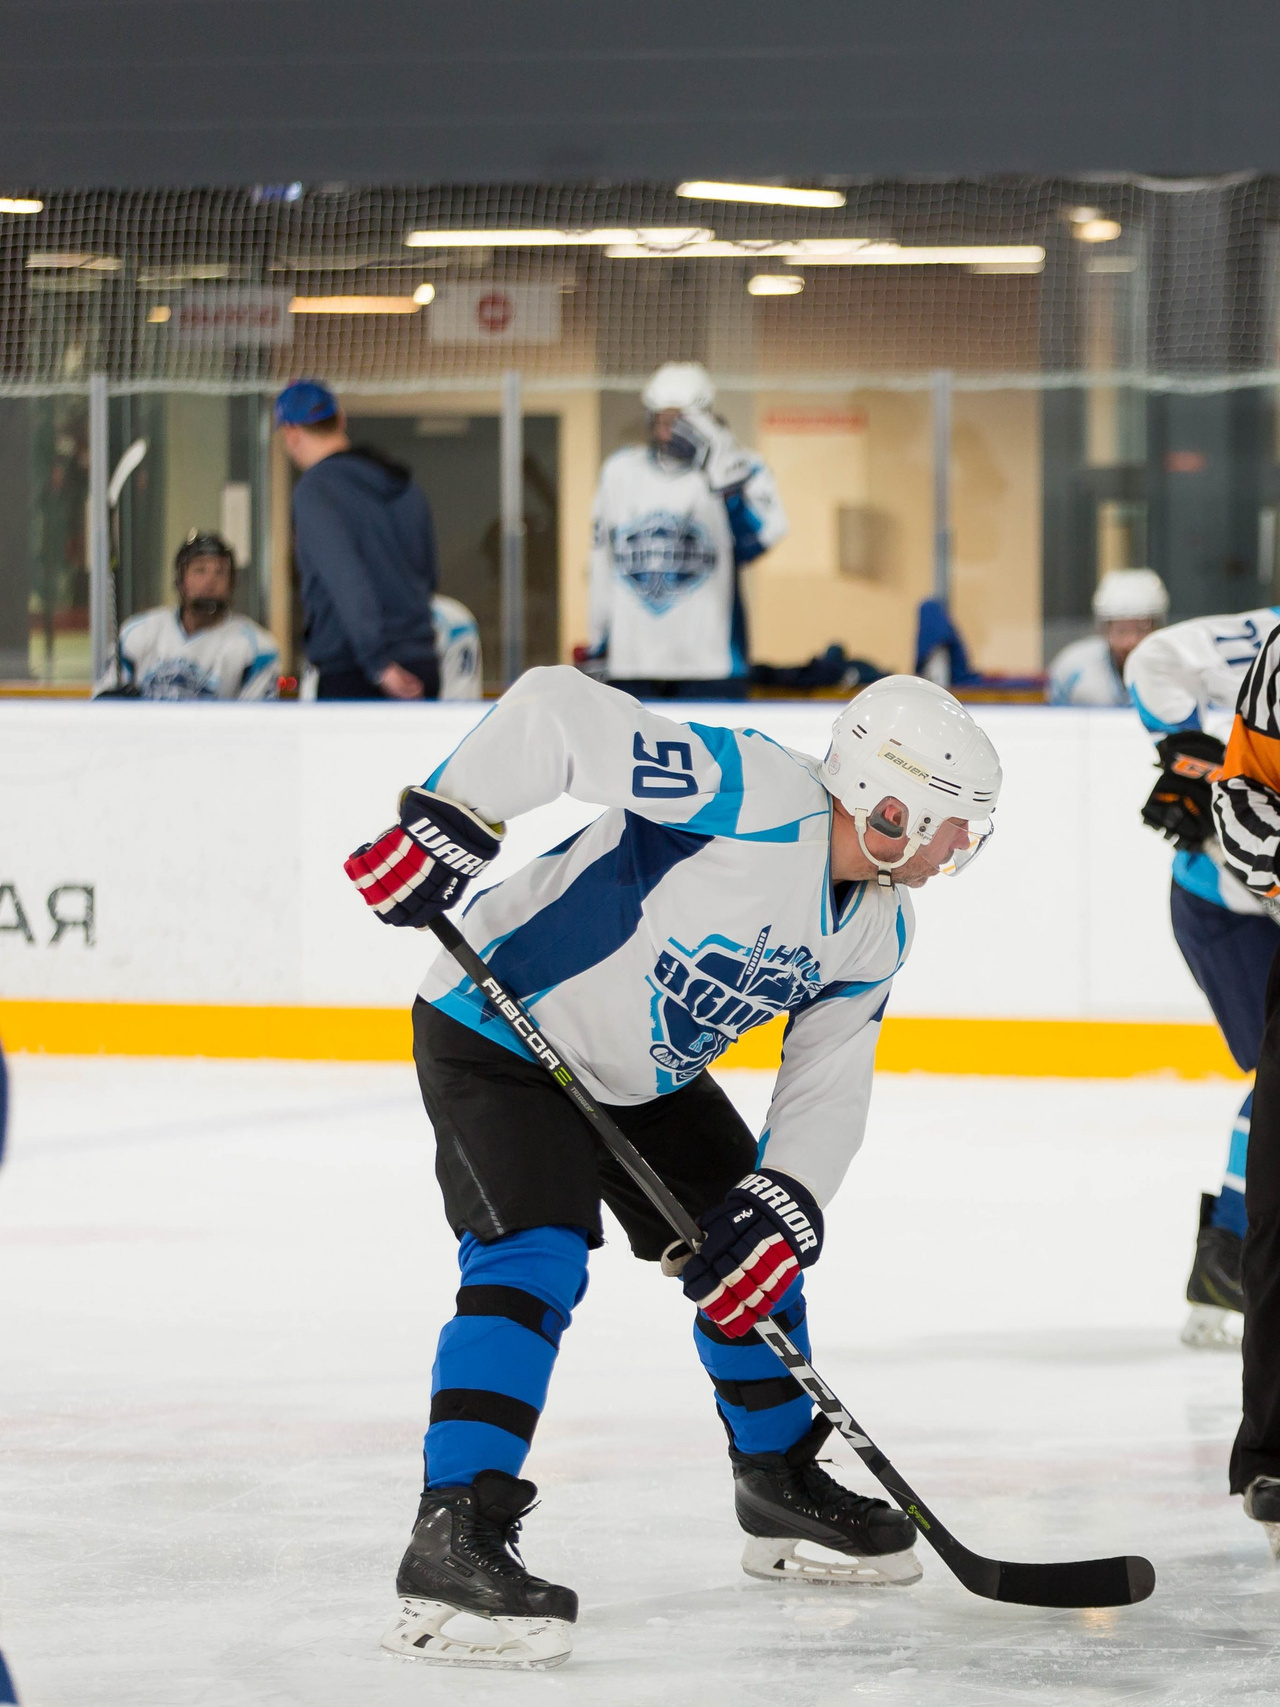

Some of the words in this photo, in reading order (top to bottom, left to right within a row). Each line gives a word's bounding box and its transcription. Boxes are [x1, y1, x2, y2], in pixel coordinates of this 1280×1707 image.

[632, 731, 699, 799] 50
[884, 751, 930, 780] BAUER
[752, 1314, 875, 1450] CCM
